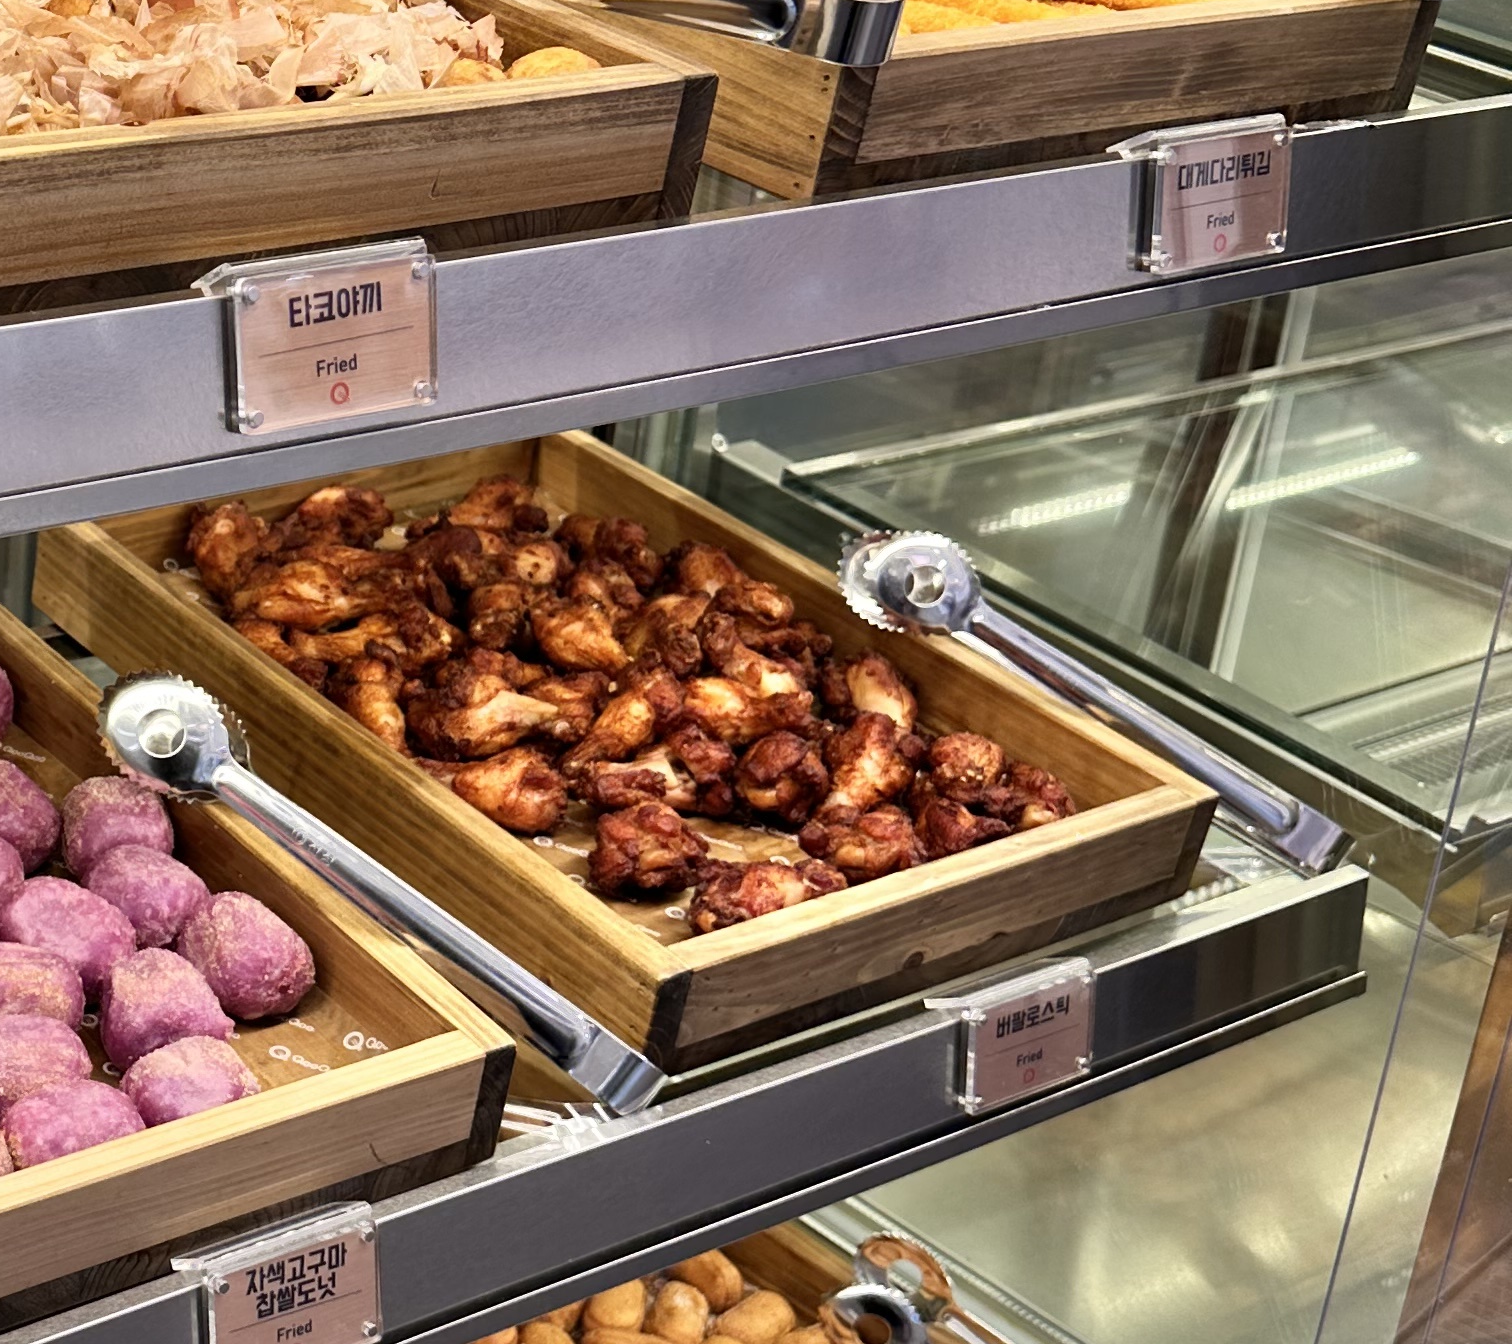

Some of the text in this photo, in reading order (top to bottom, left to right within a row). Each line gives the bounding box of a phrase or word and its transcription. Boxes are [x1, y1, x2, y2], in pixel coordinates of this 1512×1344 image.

[1177, 149, 1272, 192] 대게다리튀김
[1205, 210, 1235, 230] Fried
[288, 280, 382, 329] 타코야끼
[315, 353, 358, 378] Fried
[995, 994, 1071, 1040] 버팔로스틱
[1016, 1048, 1044, 1068] Fried
[245, 1242, 348, 1296] 자색고구마
[255, 1271, 337, 1320] 찹쌀도넛
[276, 1319, 313, 1343] Fried
